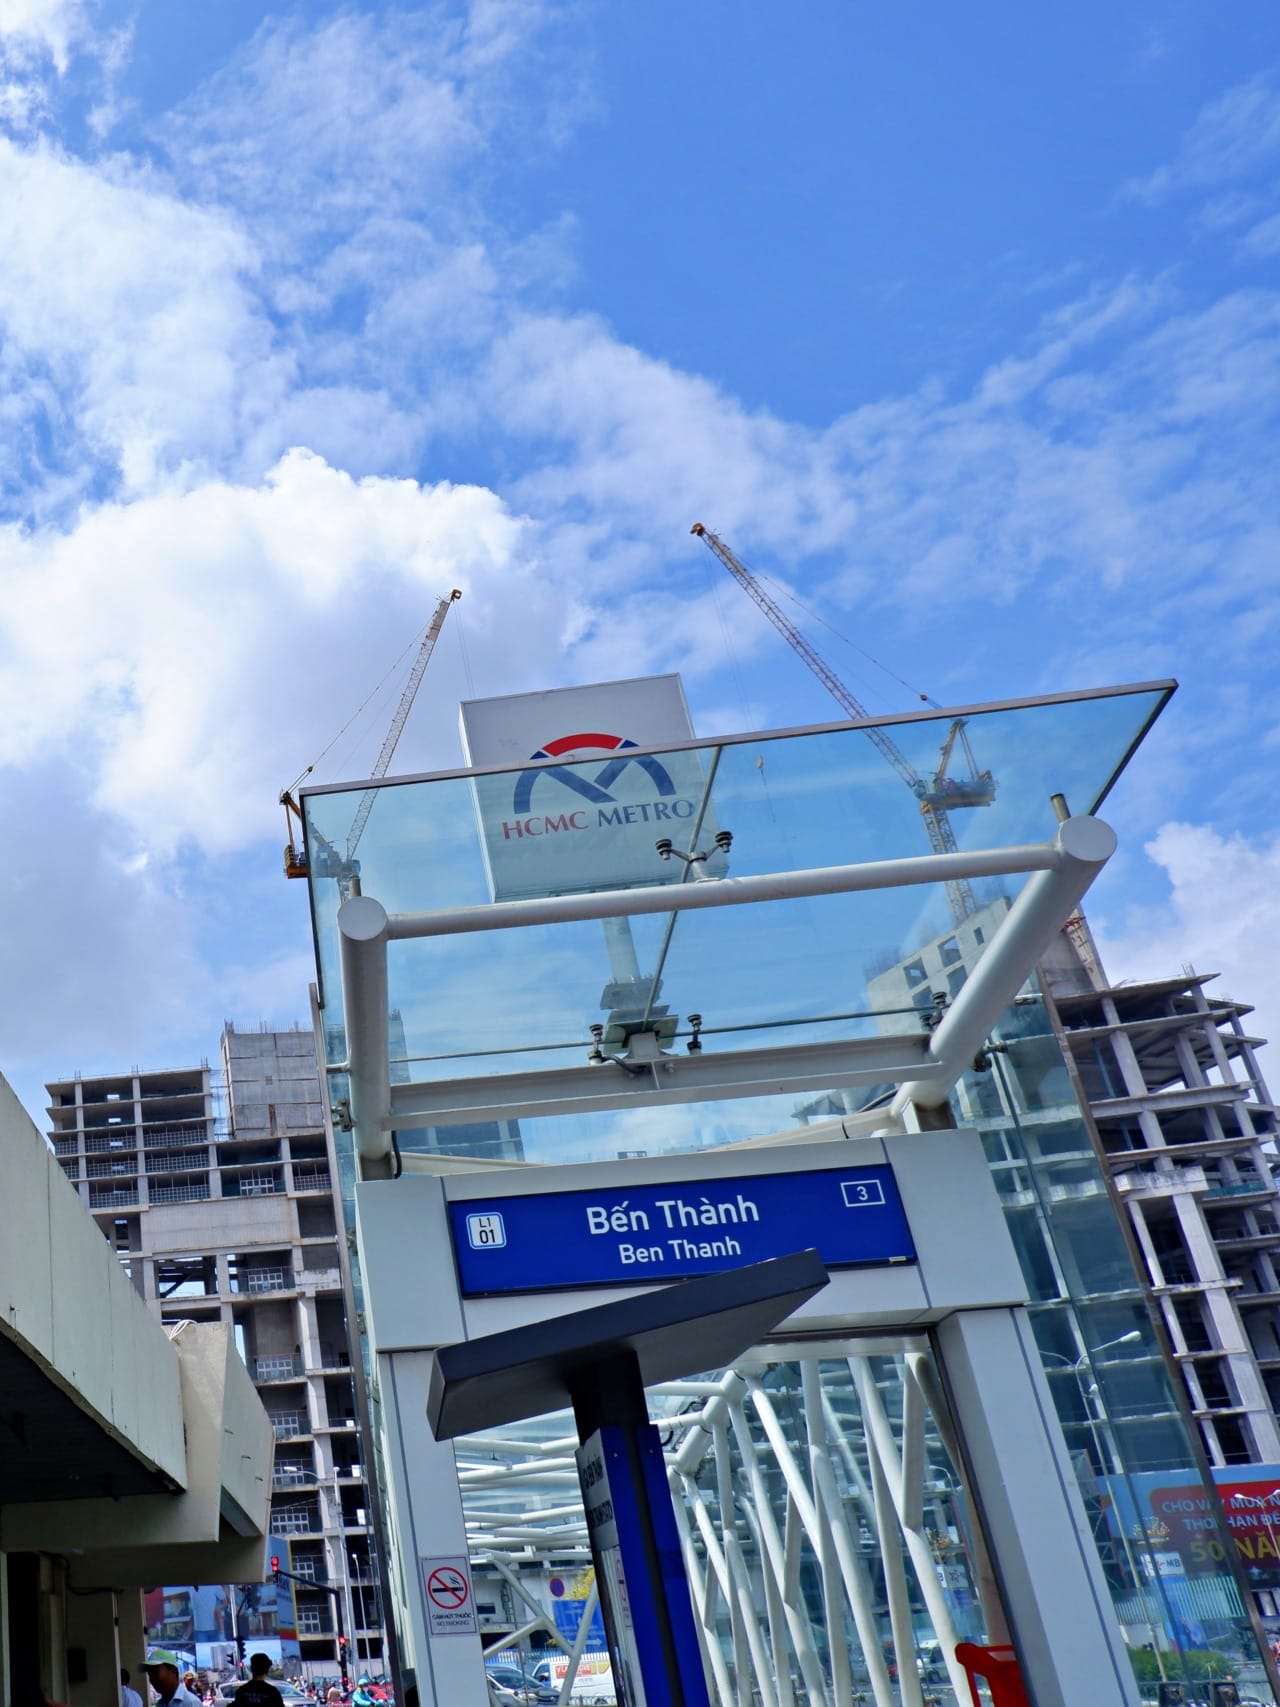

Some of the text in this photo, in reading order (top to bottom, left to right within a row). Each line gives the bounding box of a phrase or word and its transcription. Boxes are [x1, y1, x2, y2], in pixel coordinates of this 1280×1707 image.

[502, 799, 696, 840] HCMC METRO
[857, 1186, 869, 1201] 3
[478, 1217, 491, 1228] L1
[586, 1195, 760, 1235] Bến Thành
[479, 1229, 495, 1244] 01
[618, 1236, 742, 1264] Ben Thanh
[1161, 1500, 1194, 1514] CHO
[1190, 1531, 1280, 1562] 50 NĂ
[1166, 1558, 1181, 1568] MB
